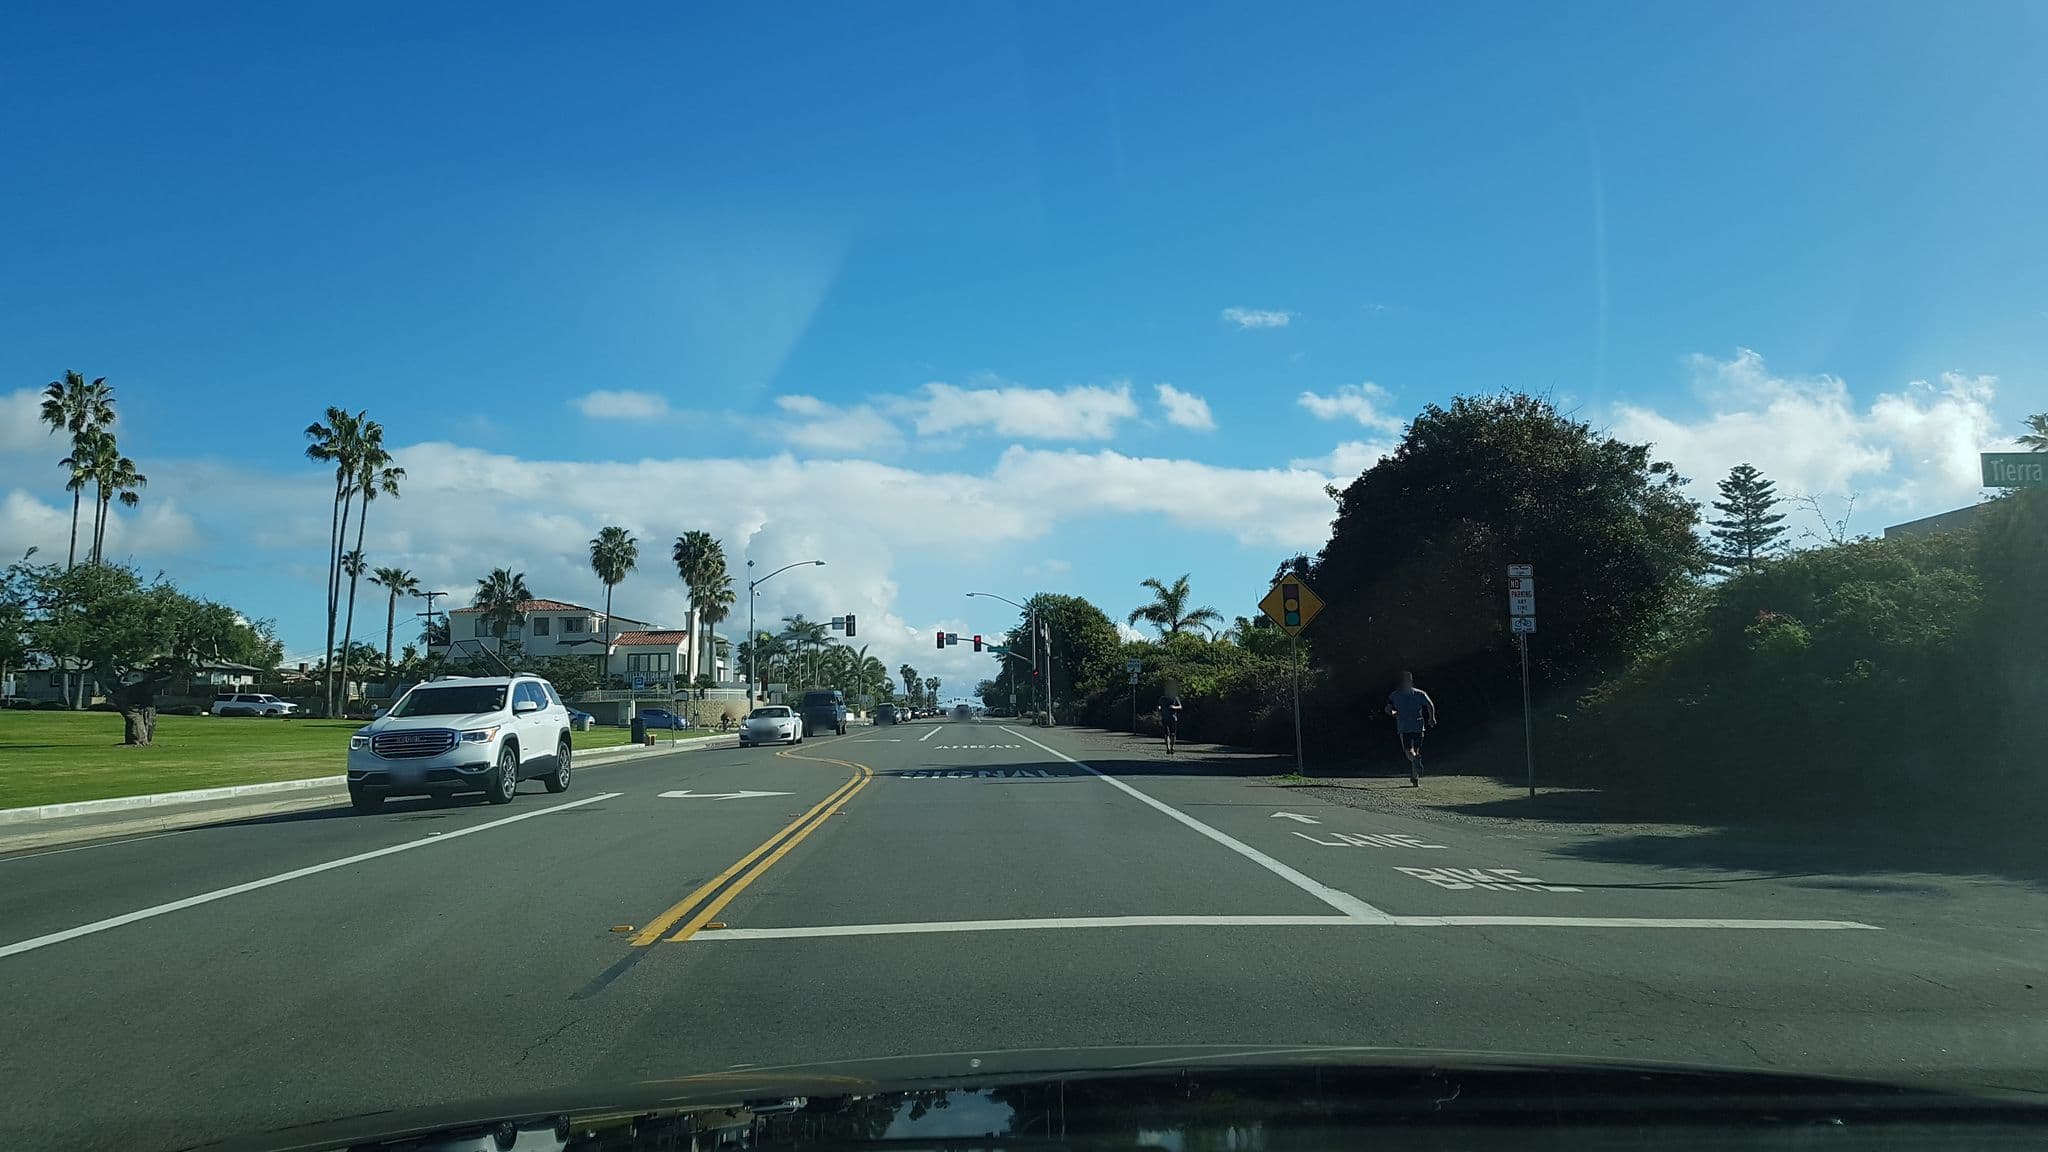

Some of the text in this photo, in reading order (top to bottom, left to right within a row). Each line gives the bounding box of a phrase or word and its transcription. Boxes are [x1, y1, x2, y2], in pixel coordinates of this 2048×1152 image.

[1990, 459, 2042, 481] Tierra
[1510, 579, 1520, 588] NO
[900, 770, 1070, 779] SIGNAL
[1291, 831, 1449, 849] LANE
[1392, 865, 1585, 893] BIKE
